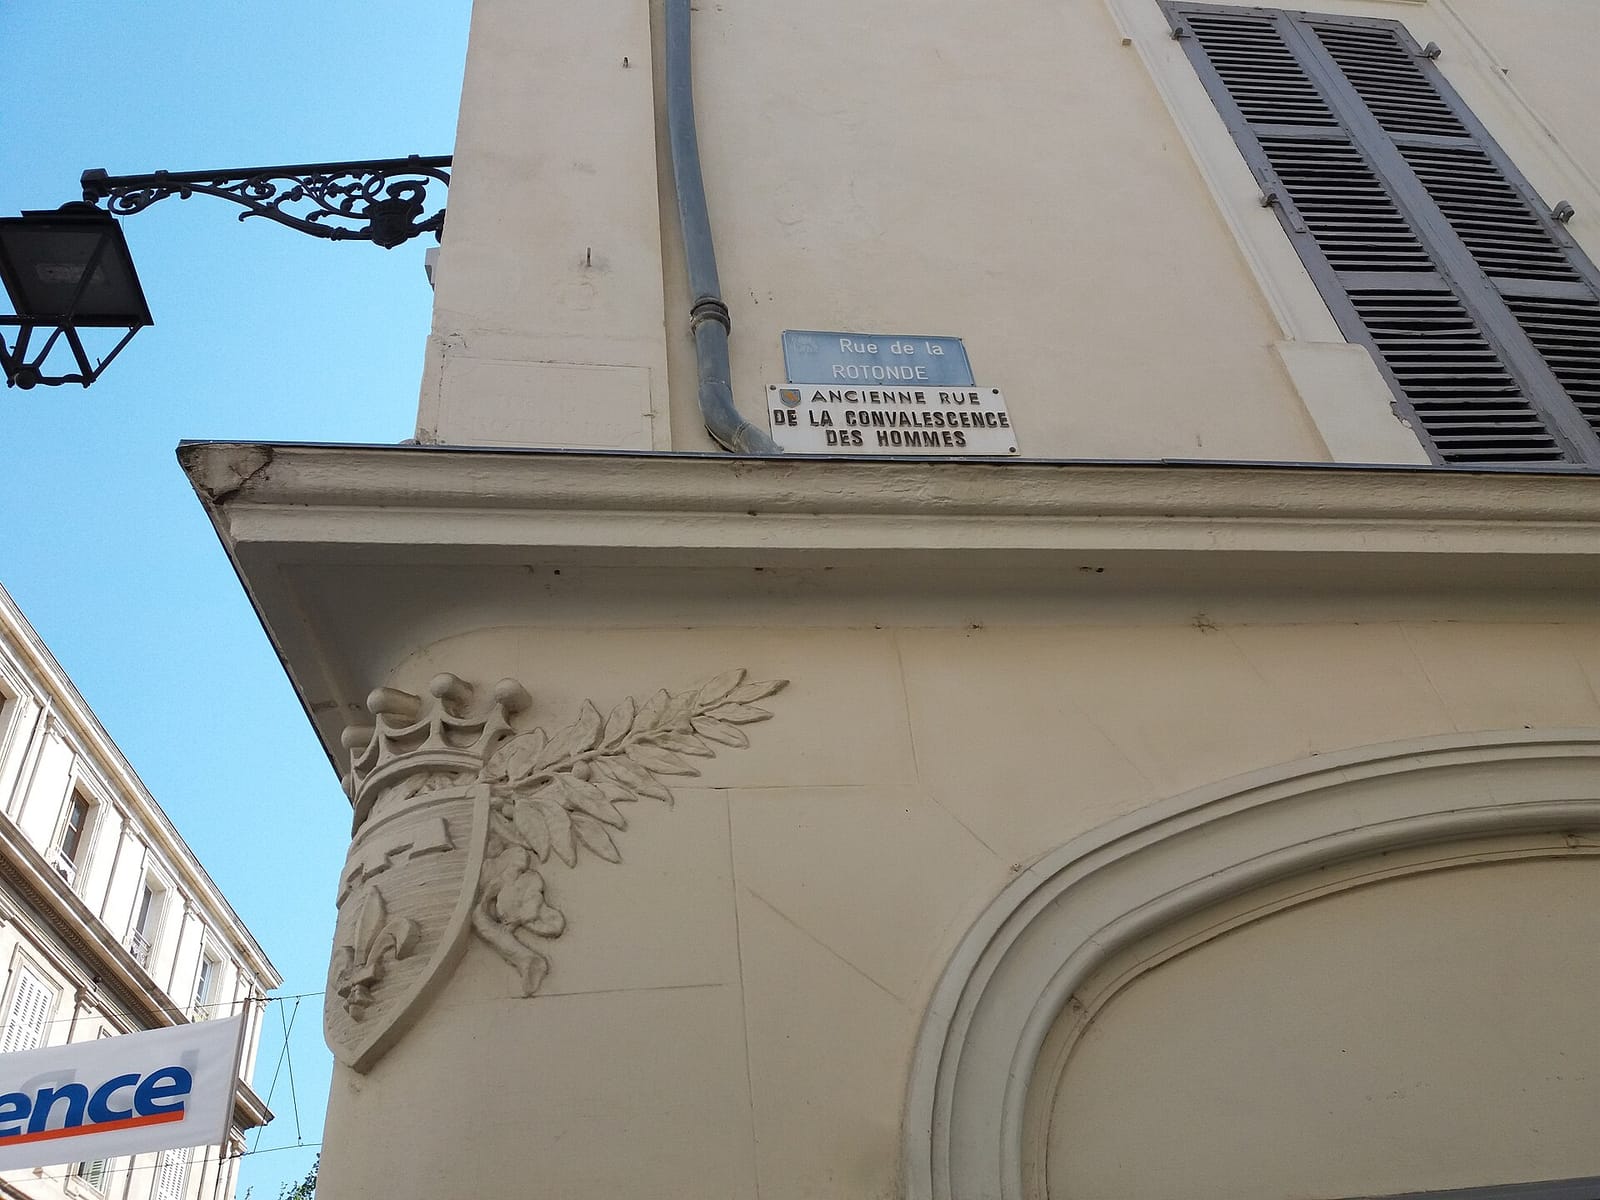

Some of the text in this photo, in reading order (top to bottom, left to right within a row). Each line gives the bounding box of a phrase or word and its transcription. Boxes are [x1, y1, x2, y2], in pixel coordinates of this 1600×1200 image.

[839, 338, 945, 356] Rue de la
[832, 364, 929, 381] ROTONDE
[811, 389, 980, 405] ANCIENNE RUE
[773, 409, 1010, 428] DE LA CONVALESCENCE
[825, 429, 967, 448] DES HOMMES
